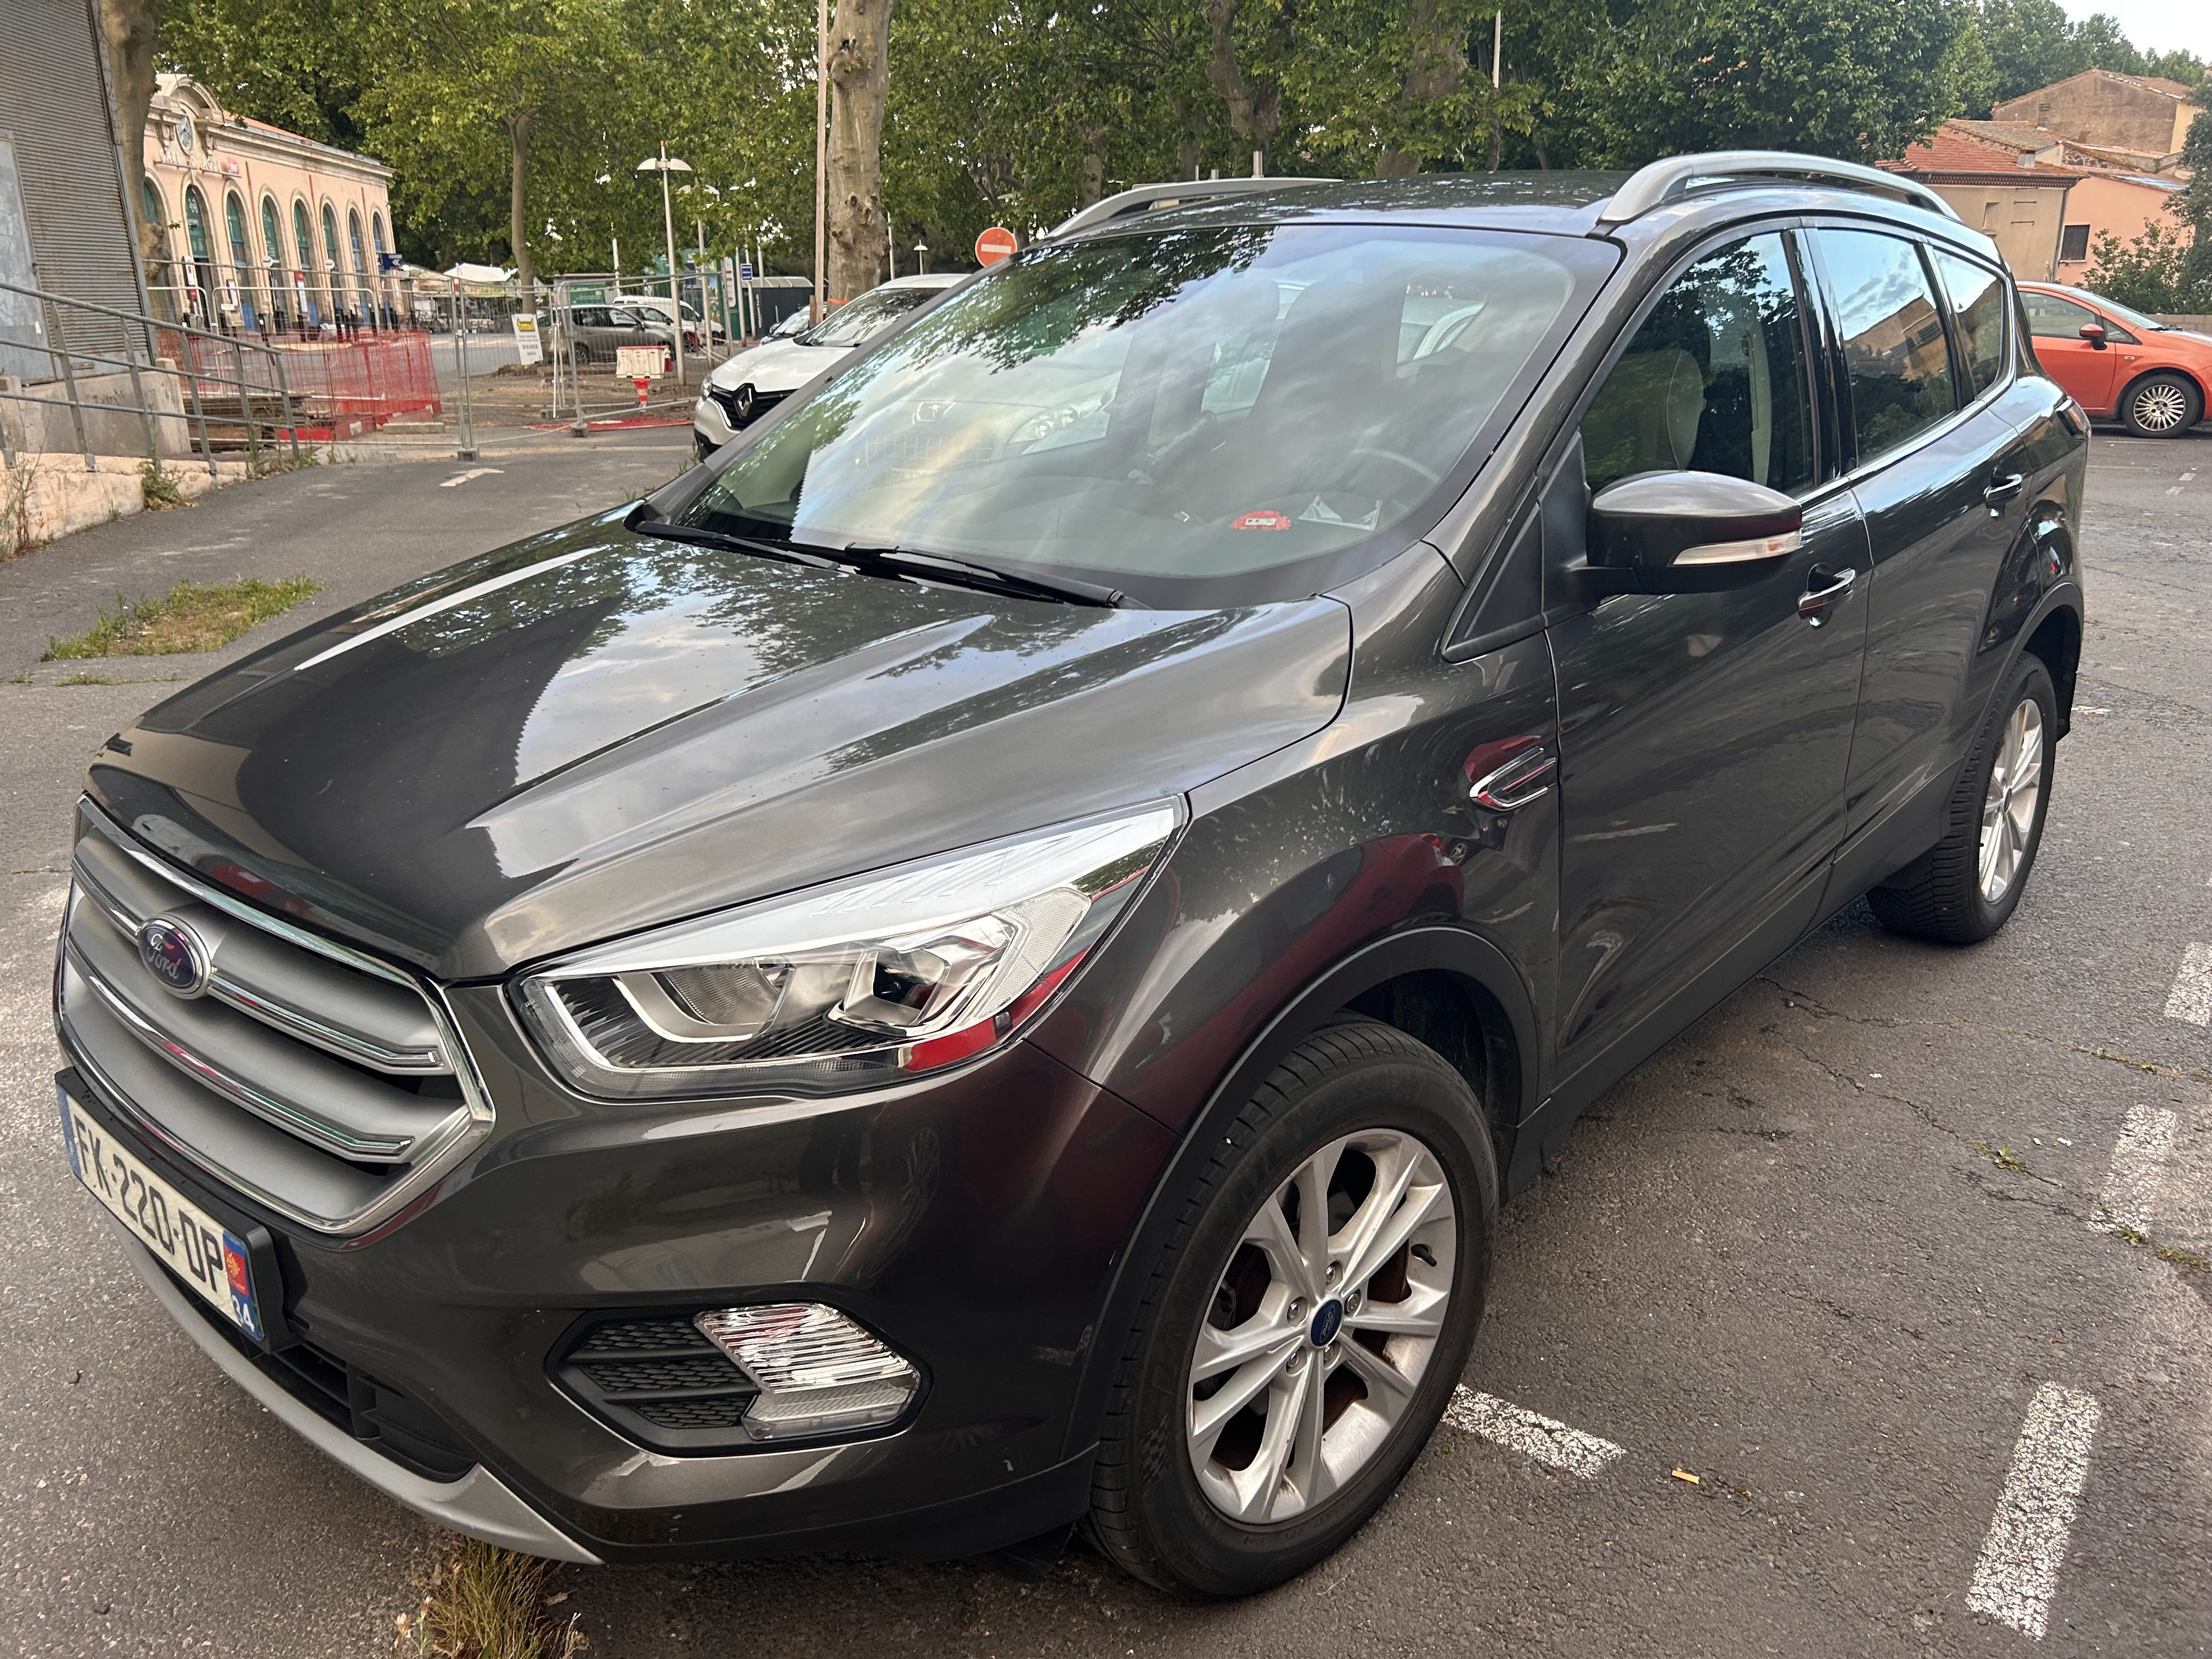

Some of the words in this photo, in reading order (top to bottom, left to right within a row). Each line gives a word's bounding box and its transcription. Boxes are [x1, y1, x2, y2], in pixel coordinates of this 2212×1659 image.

[146, 933, 180, 980] Ford
[74, 1114, 224, 1293] FK-220-DP
[232, 1295, 255, 1332] 34
[1322, 1312, 1334, 1336] Ford
